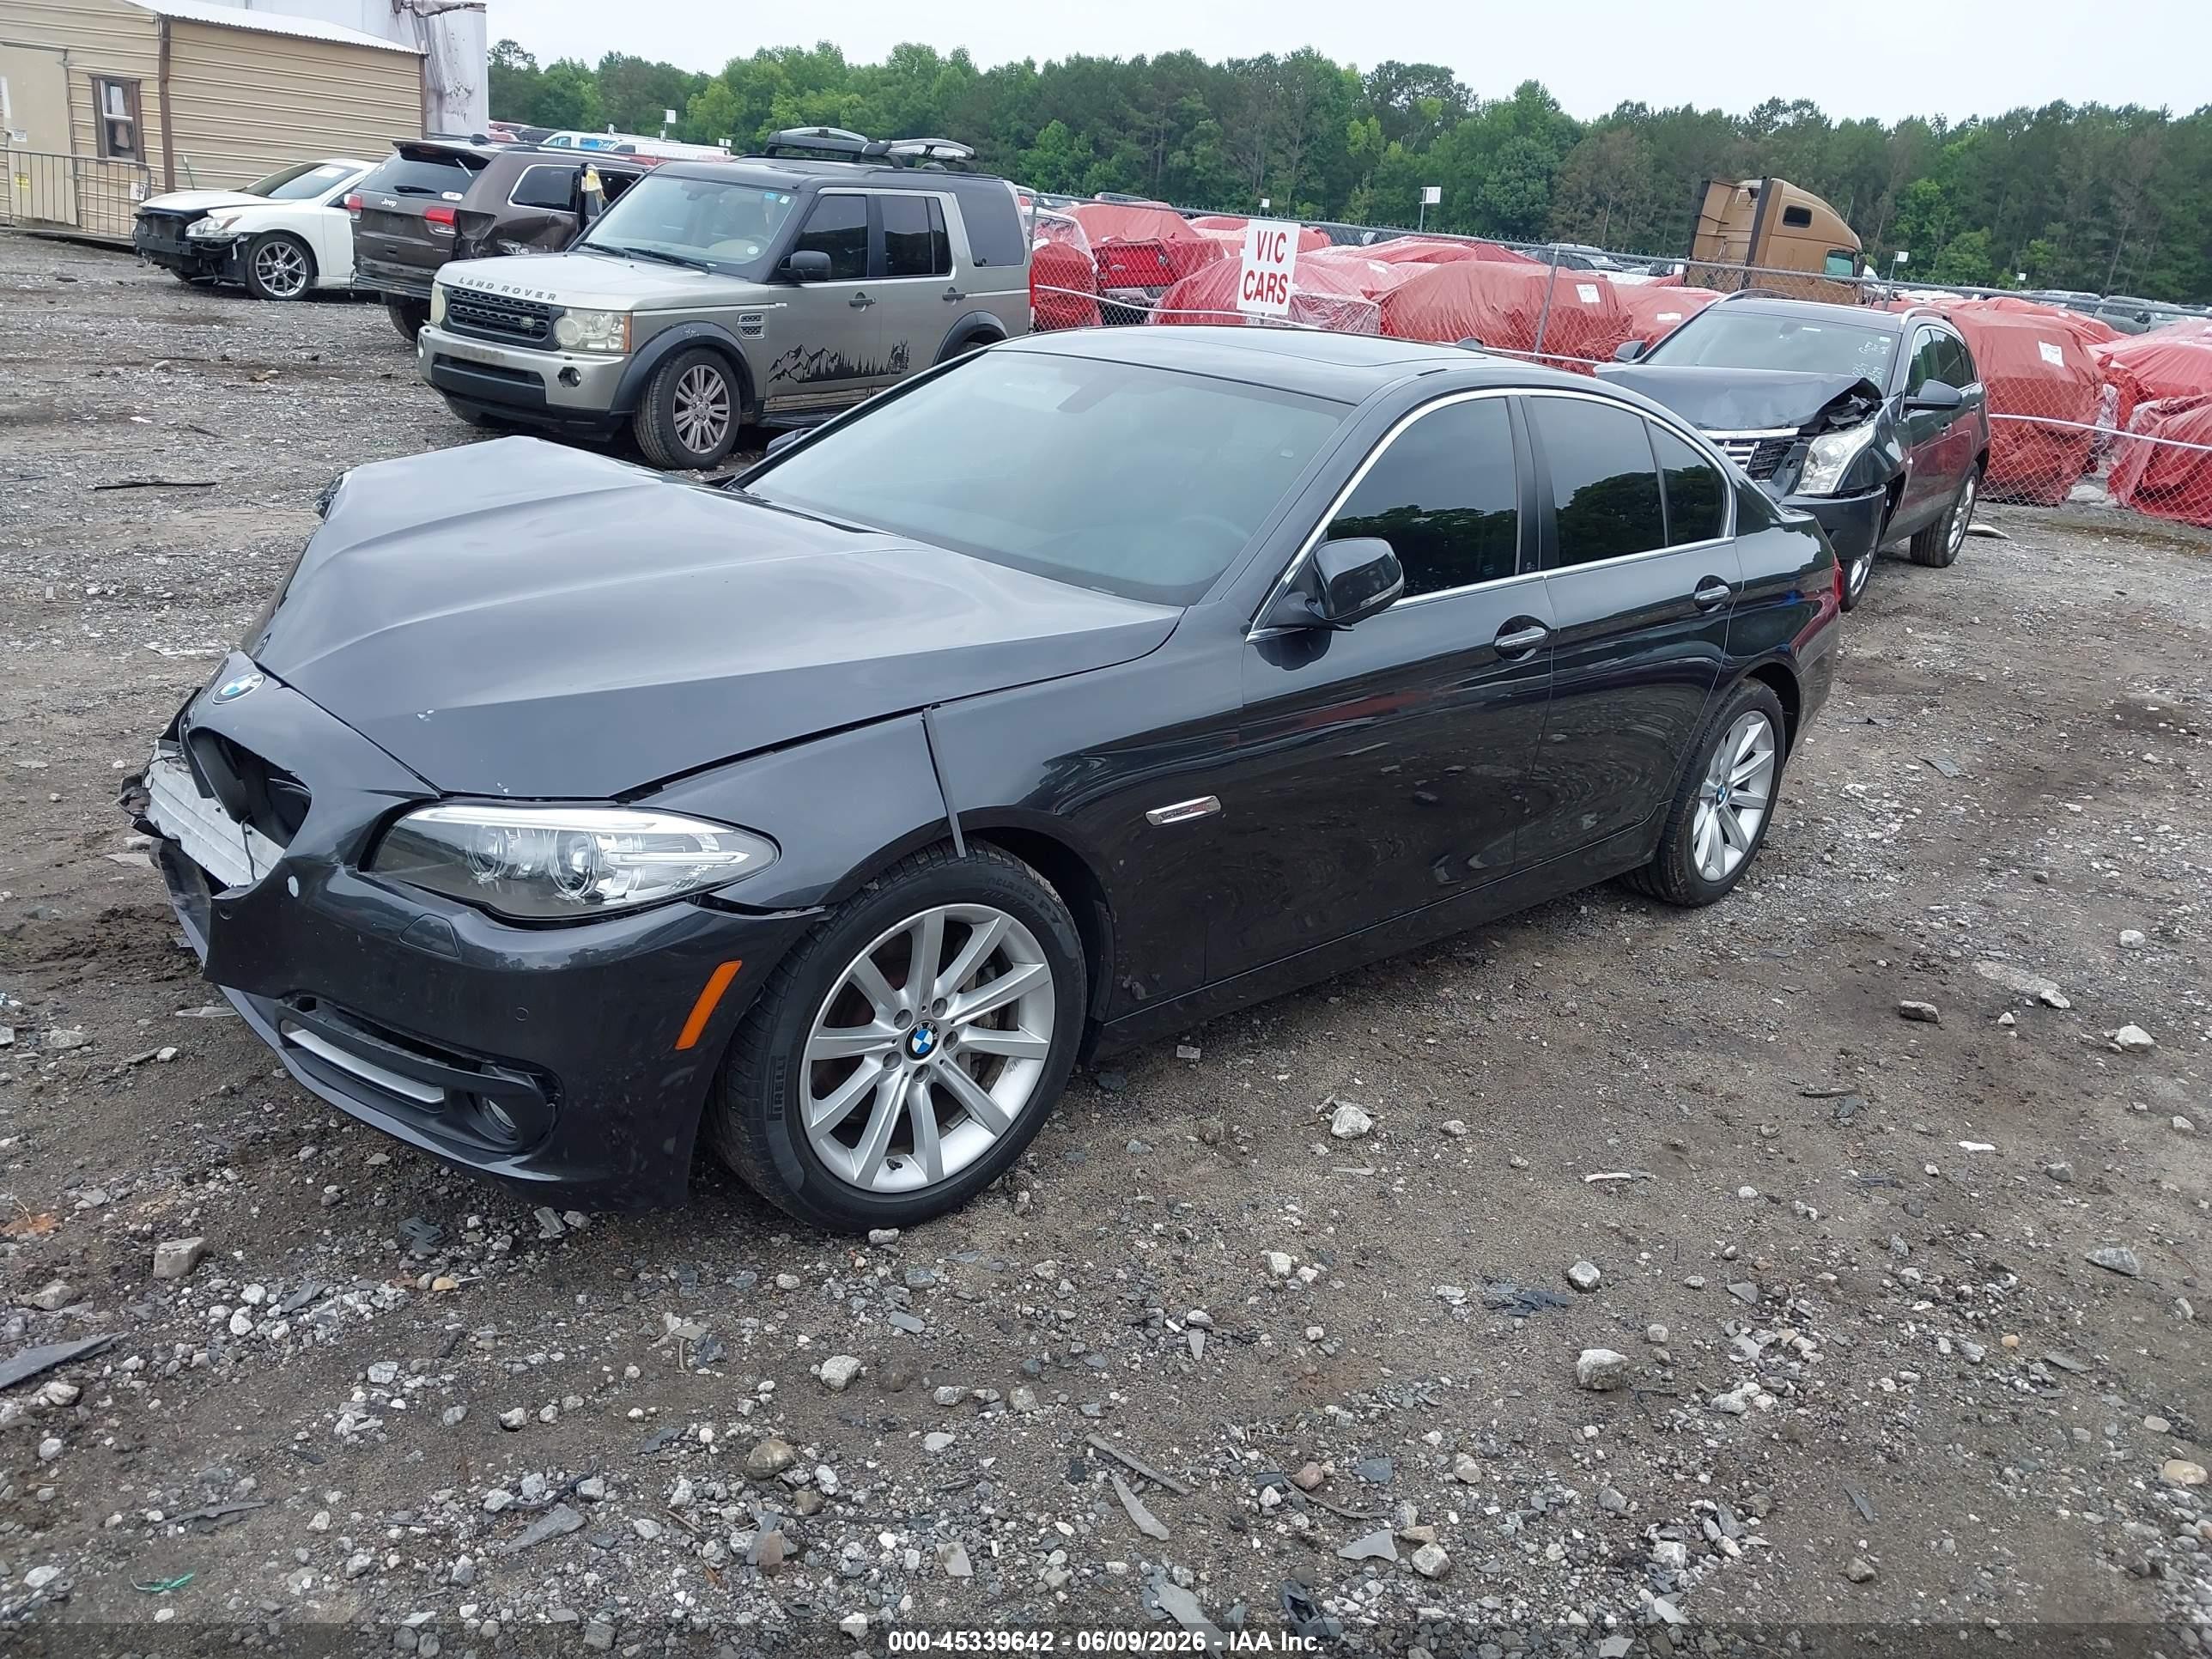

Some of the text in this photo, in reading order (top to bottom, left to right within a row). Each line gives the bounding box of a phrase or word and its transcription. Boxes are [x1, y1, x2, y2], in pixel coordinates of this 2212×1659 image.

[381, 198, 398, 208] Jeep
[1257, 230, 1286, 264] VIC
[459, 276, 556, 301] LAND ROVER
[1243, 270, 1288, 305] CARS
